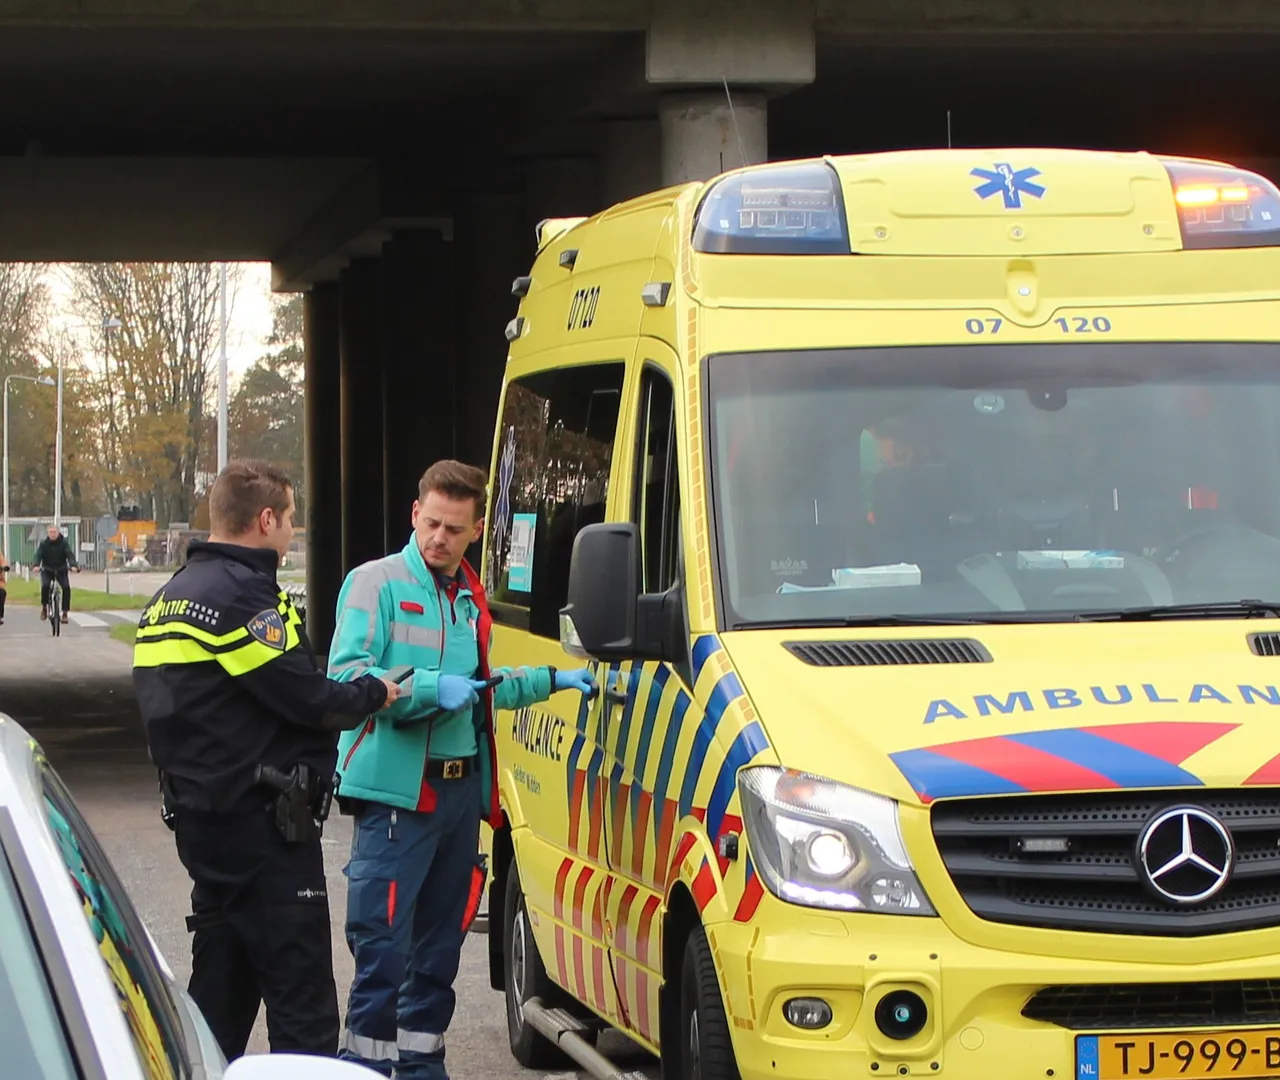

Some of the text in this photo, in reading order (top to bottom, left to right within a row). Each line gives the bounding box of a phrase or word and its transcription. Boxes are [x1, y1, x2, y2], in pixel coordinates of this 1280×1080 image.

[567, 285, 601, 332] 07120
[965, 316, 1111, 335] 07 120
[1080, 1063, 1096, 1075] NL
